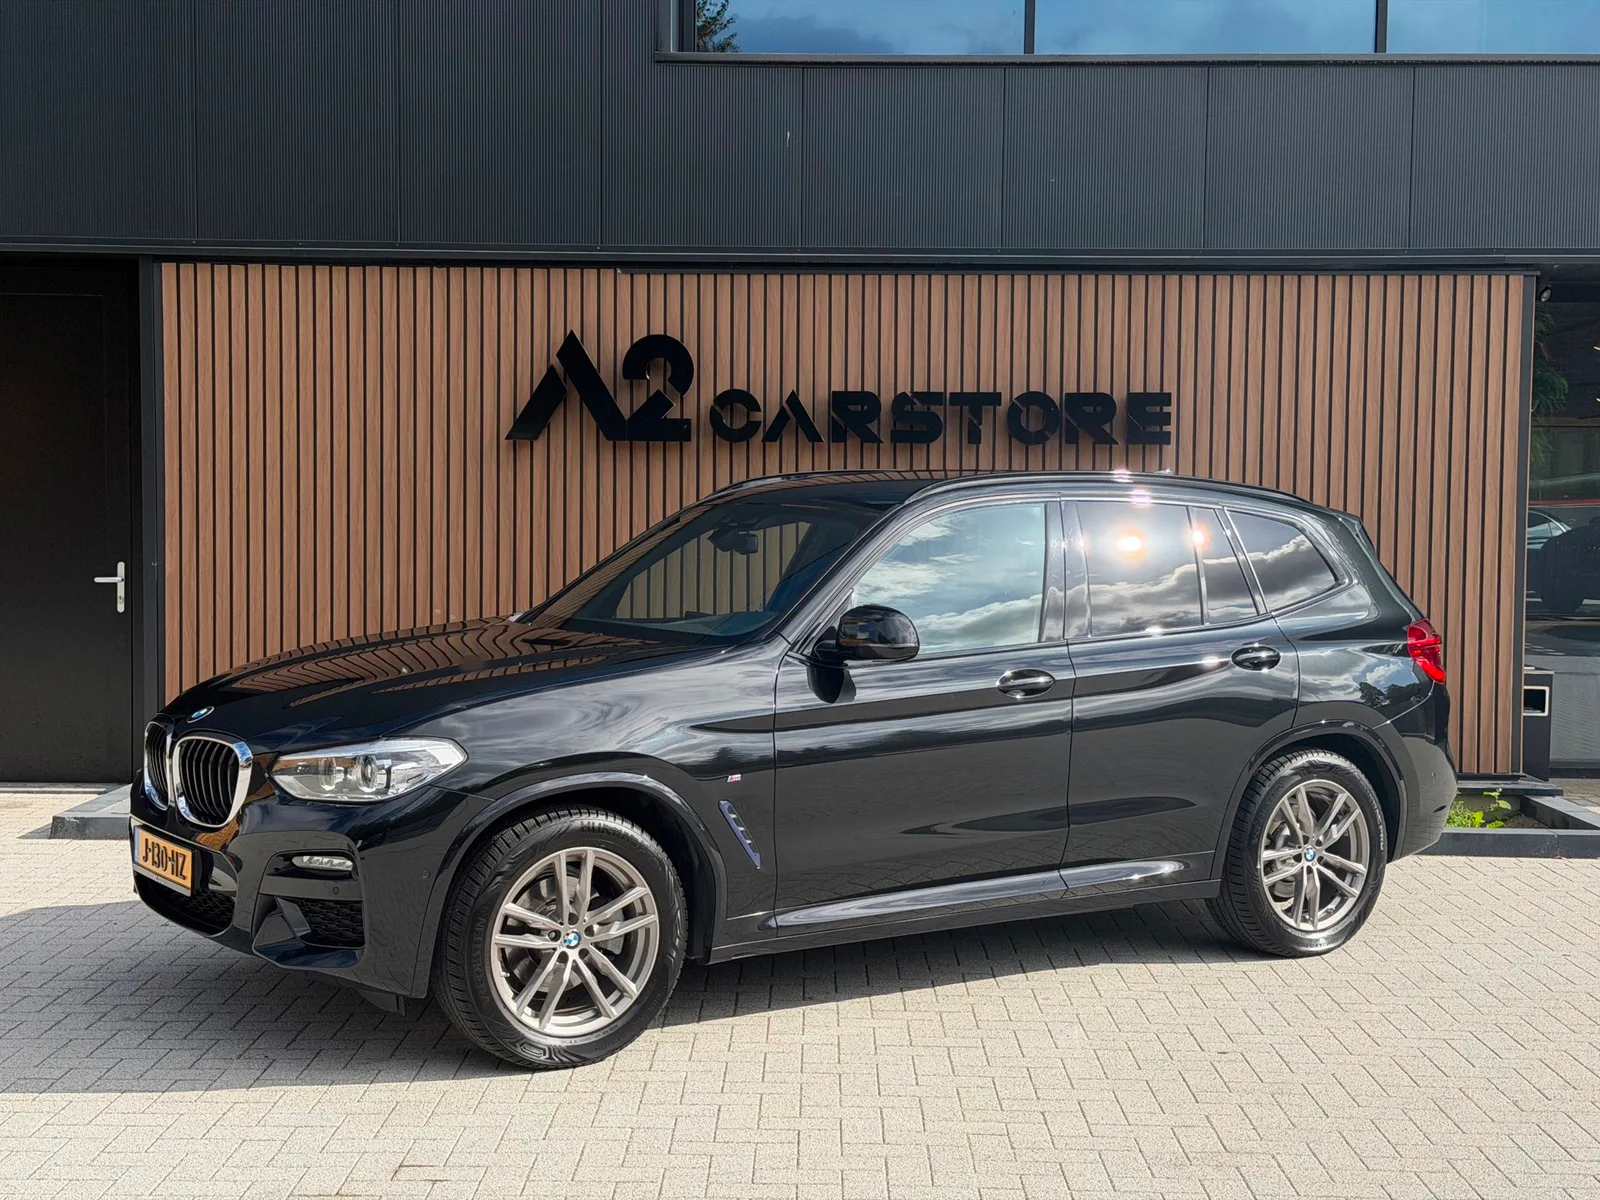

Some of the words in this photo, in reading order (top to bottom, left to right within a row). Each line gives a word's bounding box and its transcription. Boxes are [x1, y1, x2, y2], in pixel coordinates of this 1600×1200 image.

[505, 329, 694, 442] A2
[709, 388, 1172, 446] CARSTORE
[142, 837, 187, 881] J-130-HZ
